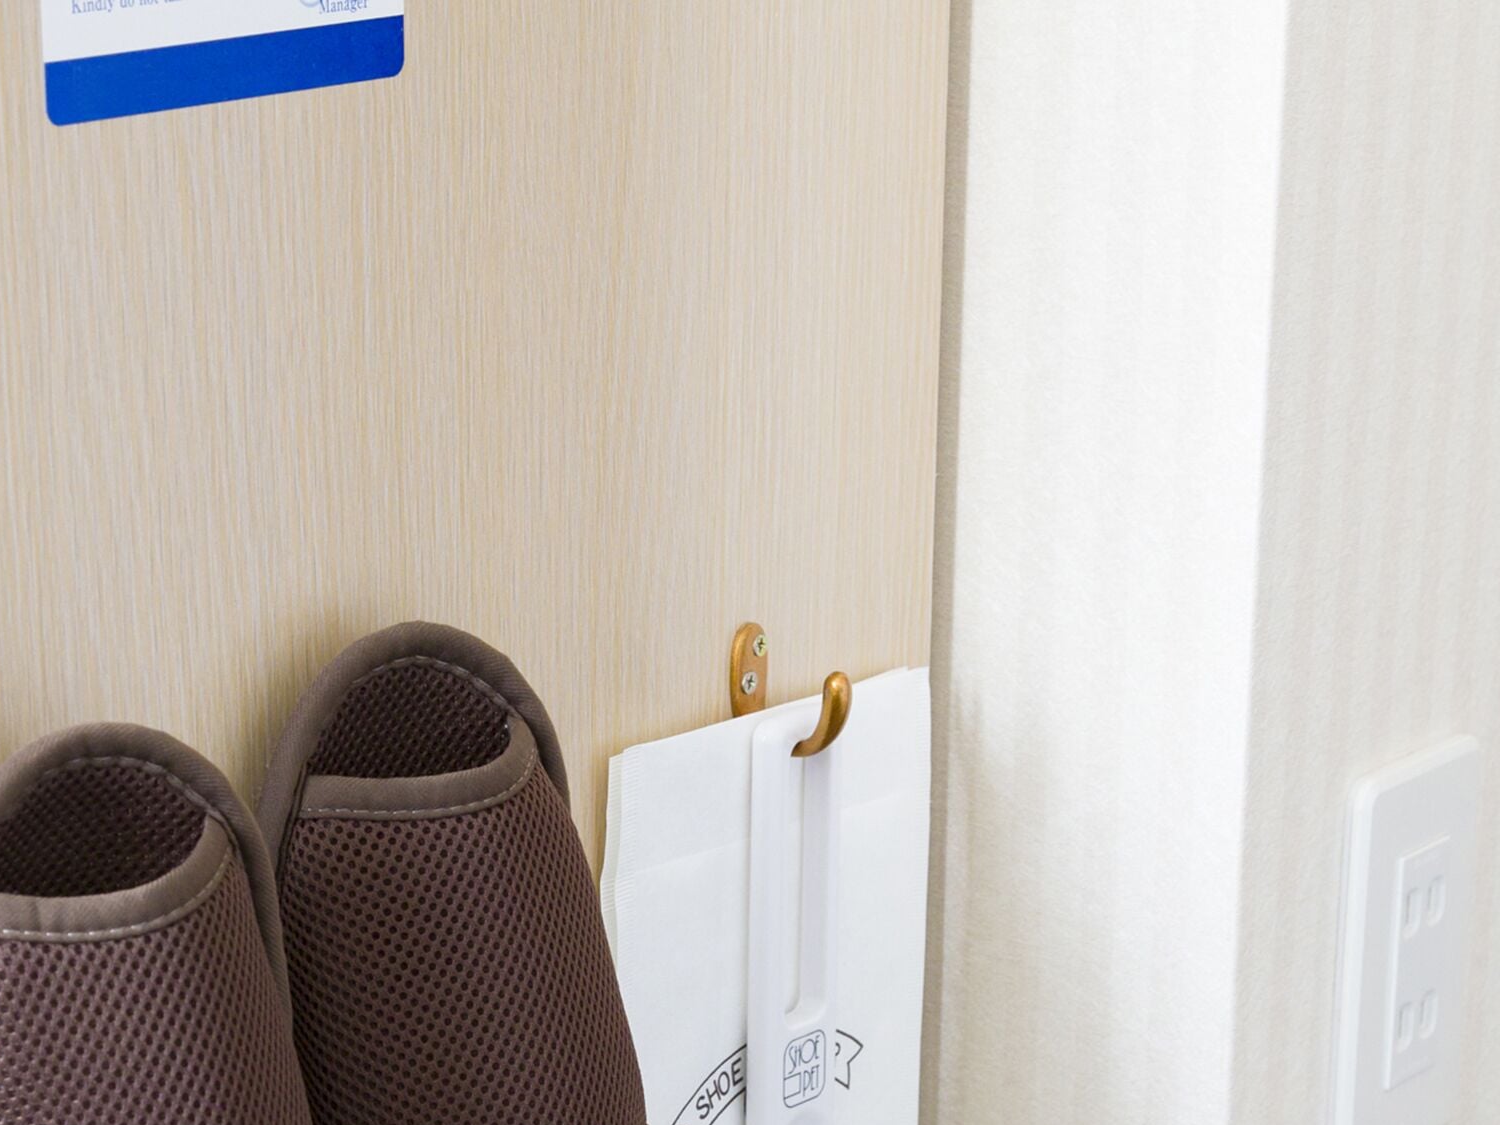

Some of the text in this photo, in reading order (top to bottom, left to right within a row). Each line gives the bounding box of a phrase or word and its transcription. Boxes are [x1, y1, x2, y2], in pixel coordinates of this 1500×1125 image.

[71, 0, 114, 14] Kindly
[318, 0, 368, 14] Manager
[788, 1034, 821, 1075] SHOE
[695, 1057, 744, 1120] SHOE
[802, 1064, 820, 1098] PET
